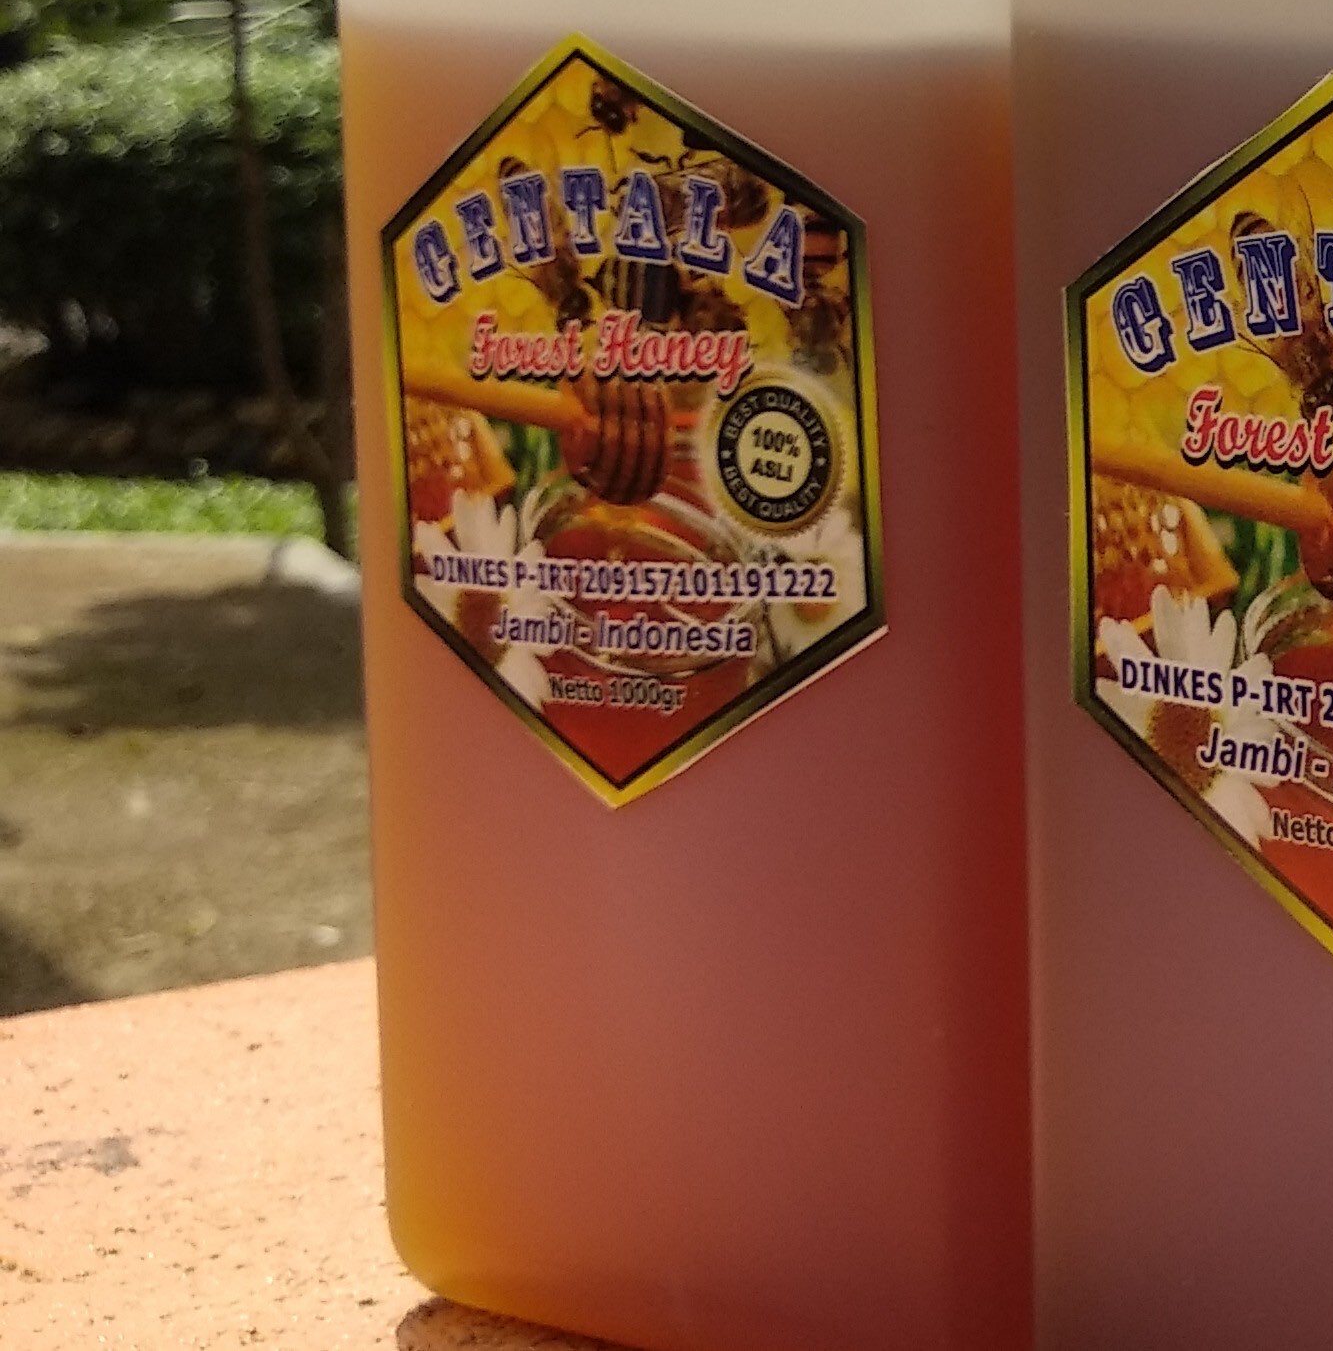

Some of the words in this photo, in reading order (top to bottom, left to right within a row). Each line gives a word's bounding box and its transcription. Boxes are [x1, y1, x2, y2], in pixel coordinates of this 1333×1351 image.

[413, 167, 805, 307] GENTALA
[471, 310, 584, 379] Forest
[595, 309, 752, 396] Honey
[724, 395, 759, 439] BEST
[766, 392, 828, 447] QUALITY
[752, 427, 799, 458] 100%
[751, 458, 793, 483] ASLI
[432, 555, 508, 587] DINKES
[516, 560, 578, 591] P-IRT
[583, 564, 837, 599] 209157101191222
[493, 607, 575, 646] Jambi
[598, 612, 754, 651] Indonesia
[550, 677, 602, 702] Netto
[610, 682, 685, 711] 1000gr
[1121, 658, 1224, 704] DINKES
[1232, 675, 1313, 718] P-IRT
[1199, 727, 1305, 780] Jambi
